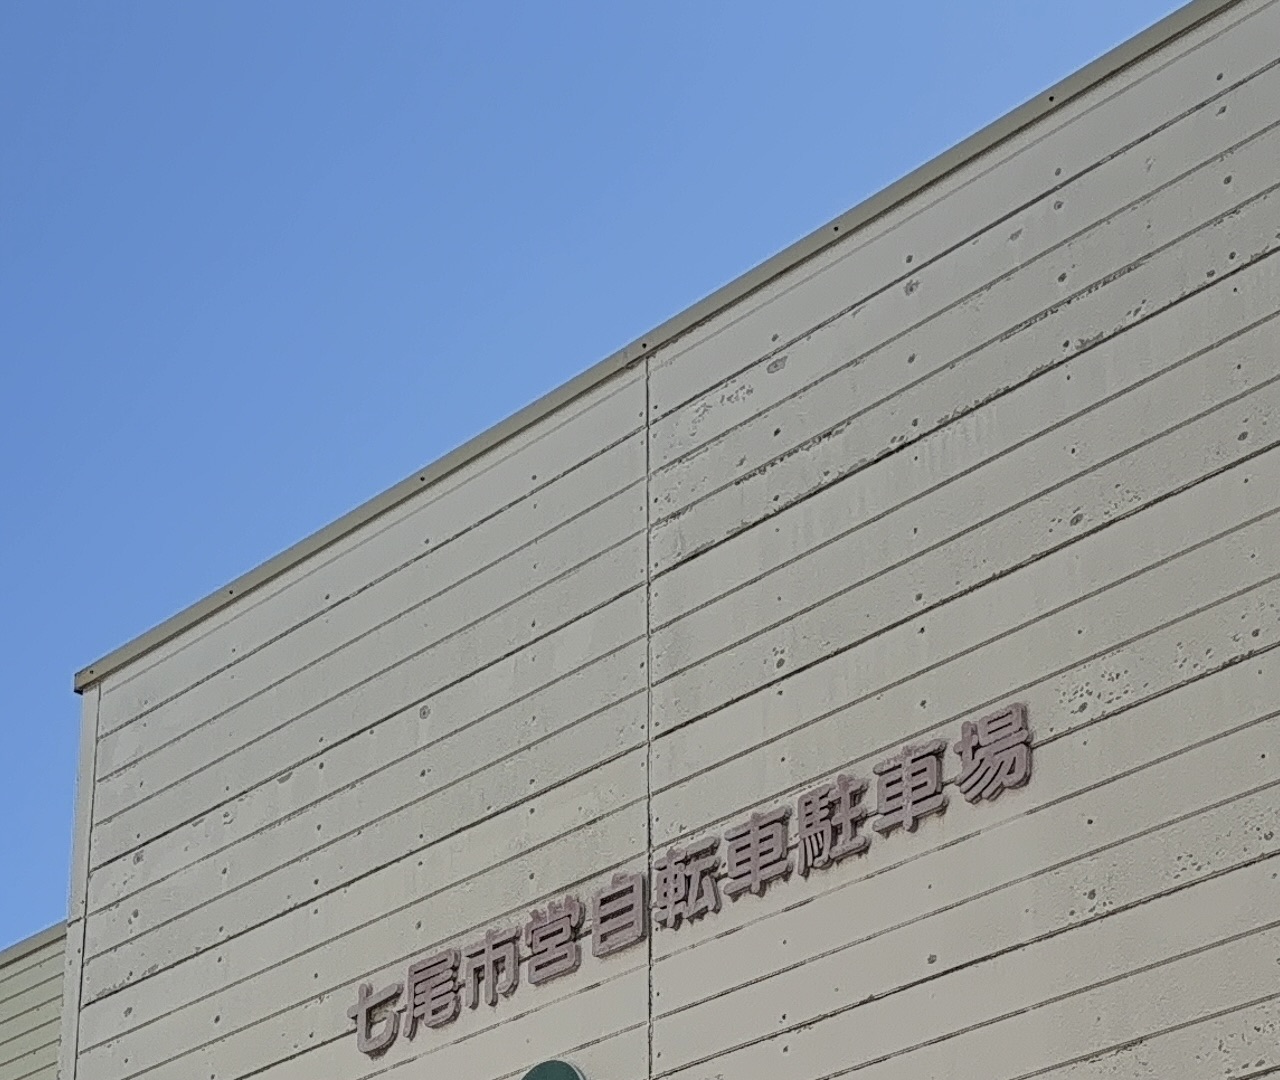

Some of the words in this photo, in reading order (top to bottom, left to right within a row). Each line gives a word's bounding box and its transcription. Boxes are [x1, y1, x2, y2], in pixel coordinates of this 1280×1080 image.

[348, 702, 1034, 1058] 七尾市営自転車駐車場
